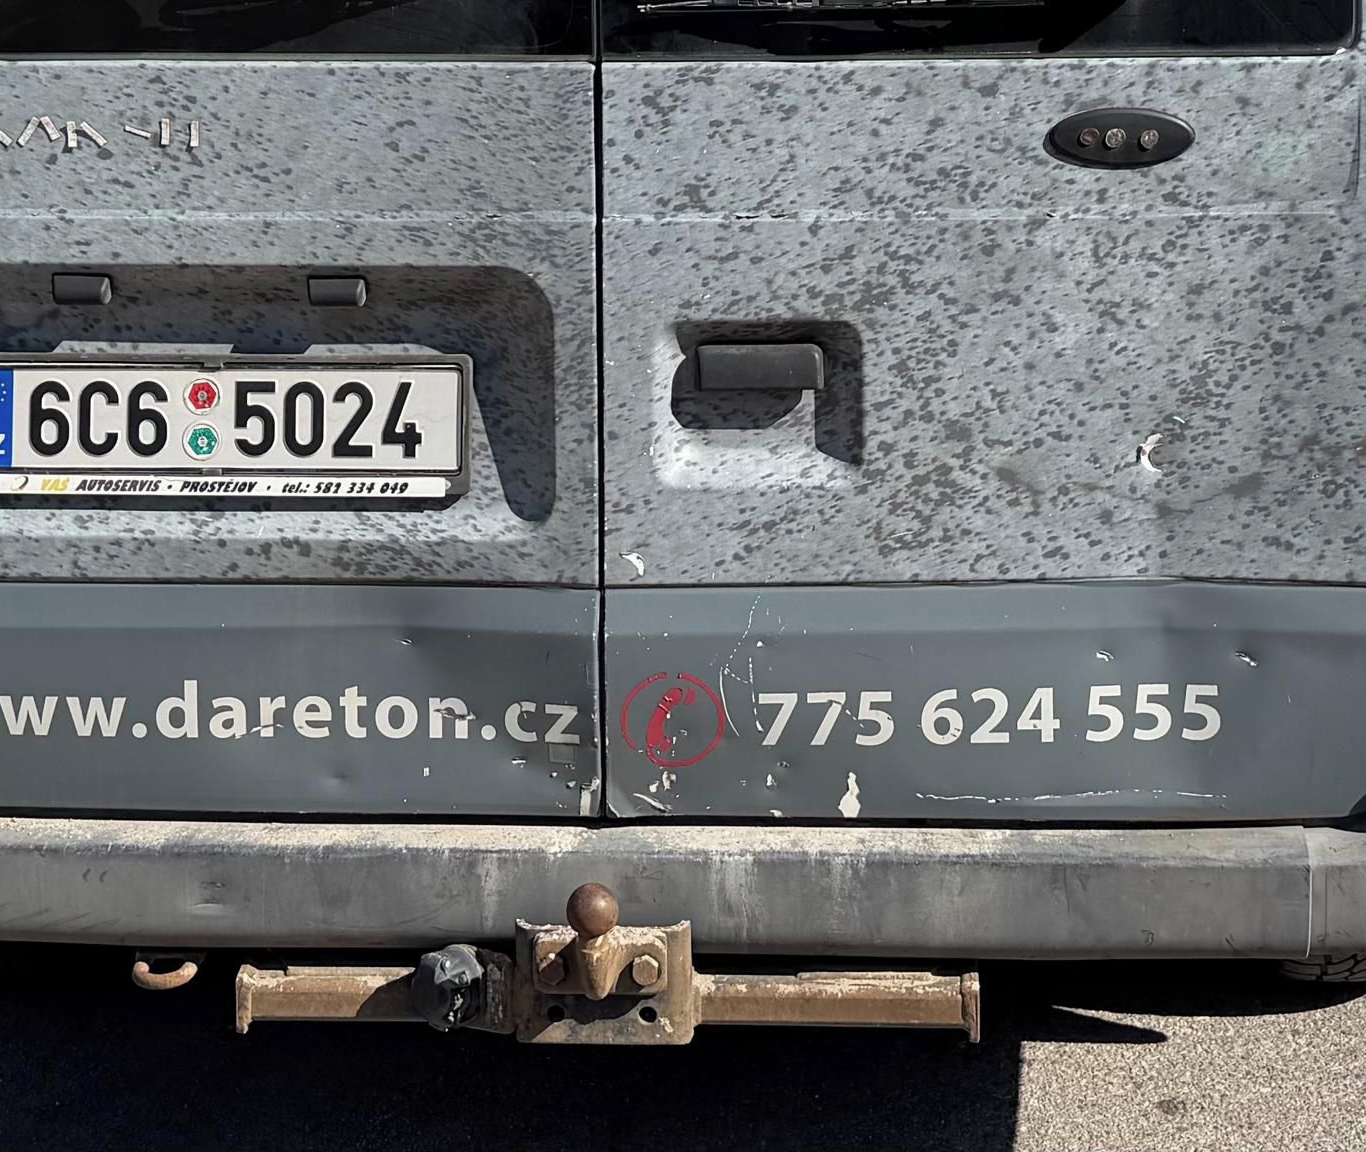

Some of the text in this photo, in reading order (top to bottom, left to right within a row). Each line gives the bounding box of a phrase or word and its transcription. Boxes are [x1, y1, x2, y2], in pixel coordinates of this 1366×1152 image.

[29, 380, 423, 458] 6C6 5024
[75, 479, 162, 492] AUTOSERVIS
[281, 481, 311, 494] tel.:
[346, 482, 375, 494] 334
[379, 482, 409, 494] 049
[758, 683, 1221, 746] 775 624 555
